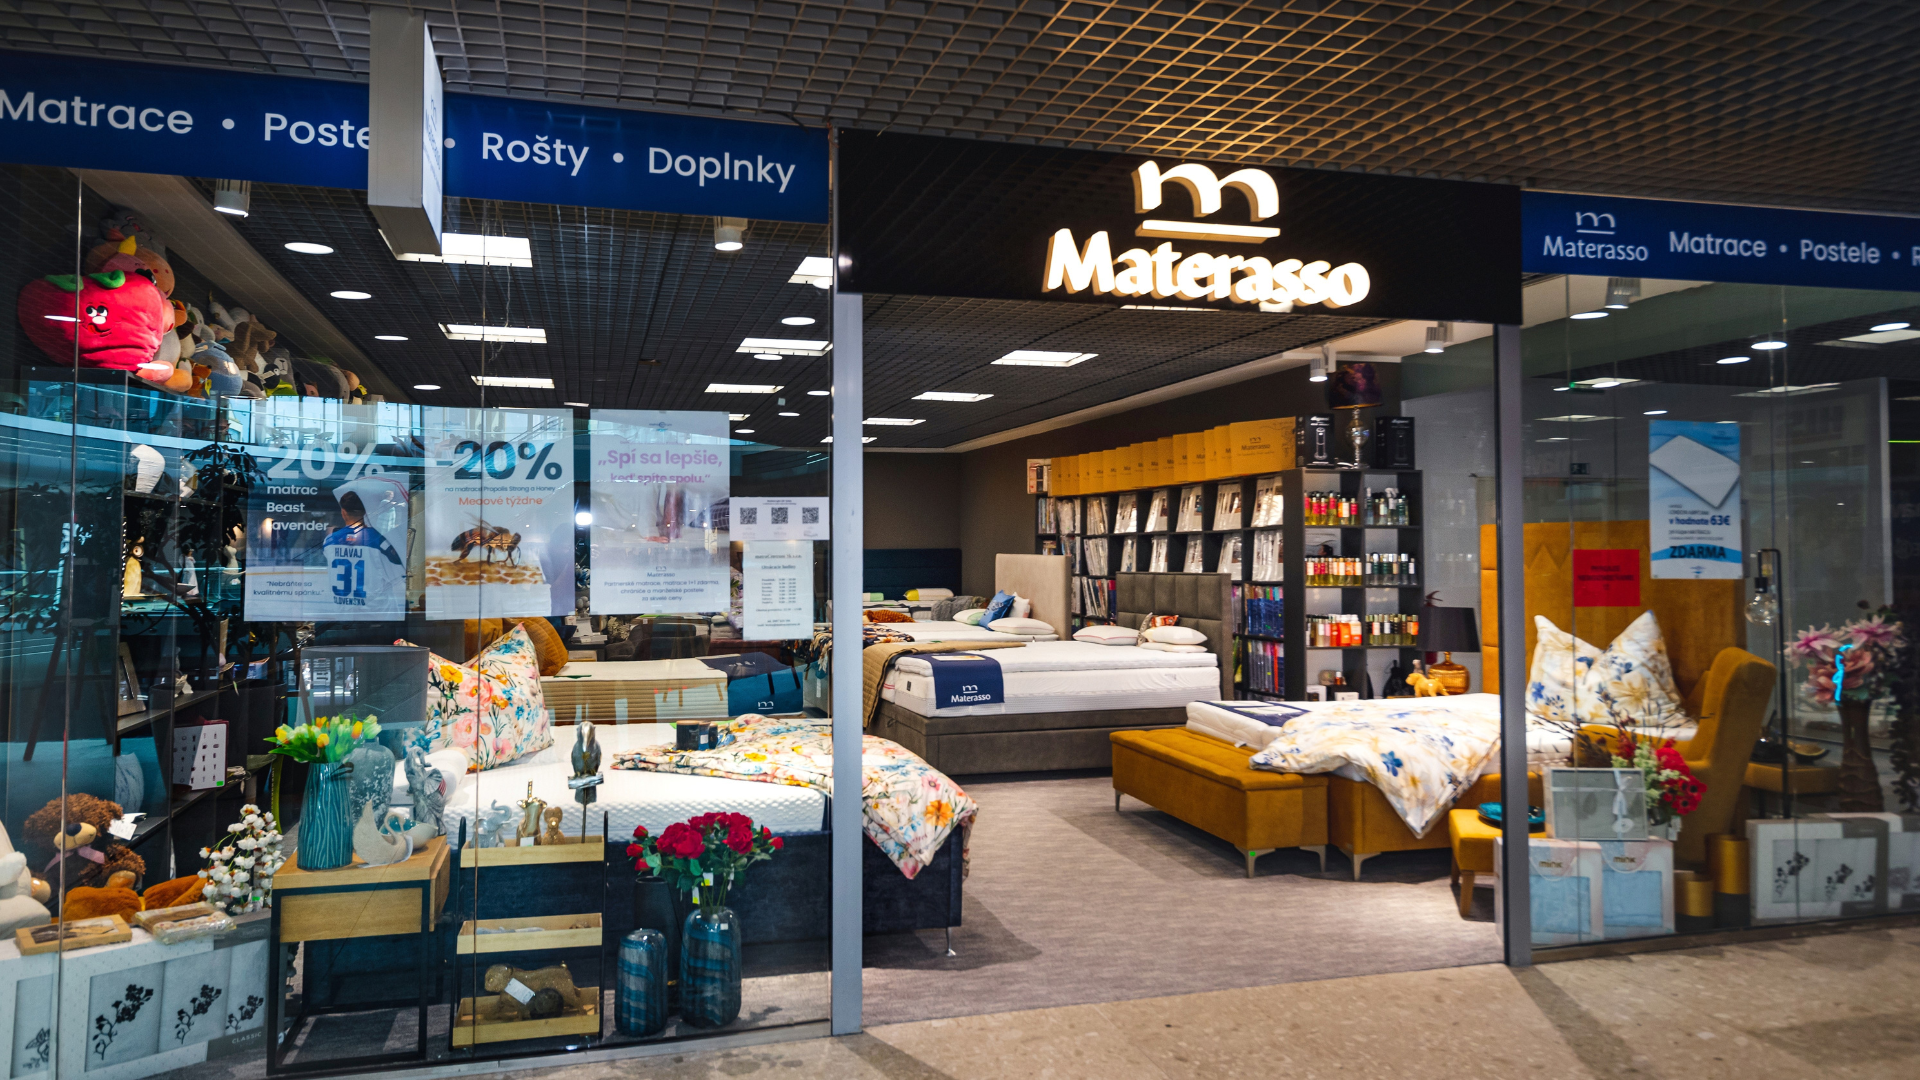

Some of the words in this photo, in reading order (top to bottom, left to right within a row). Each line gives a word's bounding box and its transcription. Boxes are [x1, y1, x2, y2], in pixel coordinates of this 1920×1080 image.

[0, 89, 193, 134] Matrace
[482, 132, 590, 176] Rošty
[649, 146, 796, 194] Doplnky
[1543, 234, 1649, 261] Materasso
[1669, 230, 1767, 258] Matrace
[1800, 238, 1881, 265] Postele
[1042, 227, 1371, 309] Materasso
[257, 439, 385, 481] -20%
[436, 440, 563, 480] -20%
[640, 453, 662, 465] sa
[665, 449, 723, 469] lepšie,
[267, 484, 318, 496] matrac
[483, 486, 508, 494] Propolis
[509, 486, 530, 494] Strong
[536, 486, 556, 494] Honey
[266, 501, 306, 513] Beast
[506, 496, 543, 508] týždne
[266, 519, 330, 532] avender
[1710, 515, 1731, 526] 63€
[334, 547, 363, 558] HLAVAJ
[1669, 545, 1727, 560] ZDARMA
[331, 558, 367, 599] 31
[951, 693, 991, 703] Materasso
[231, 1031, 262, 1044] CLASSIC
